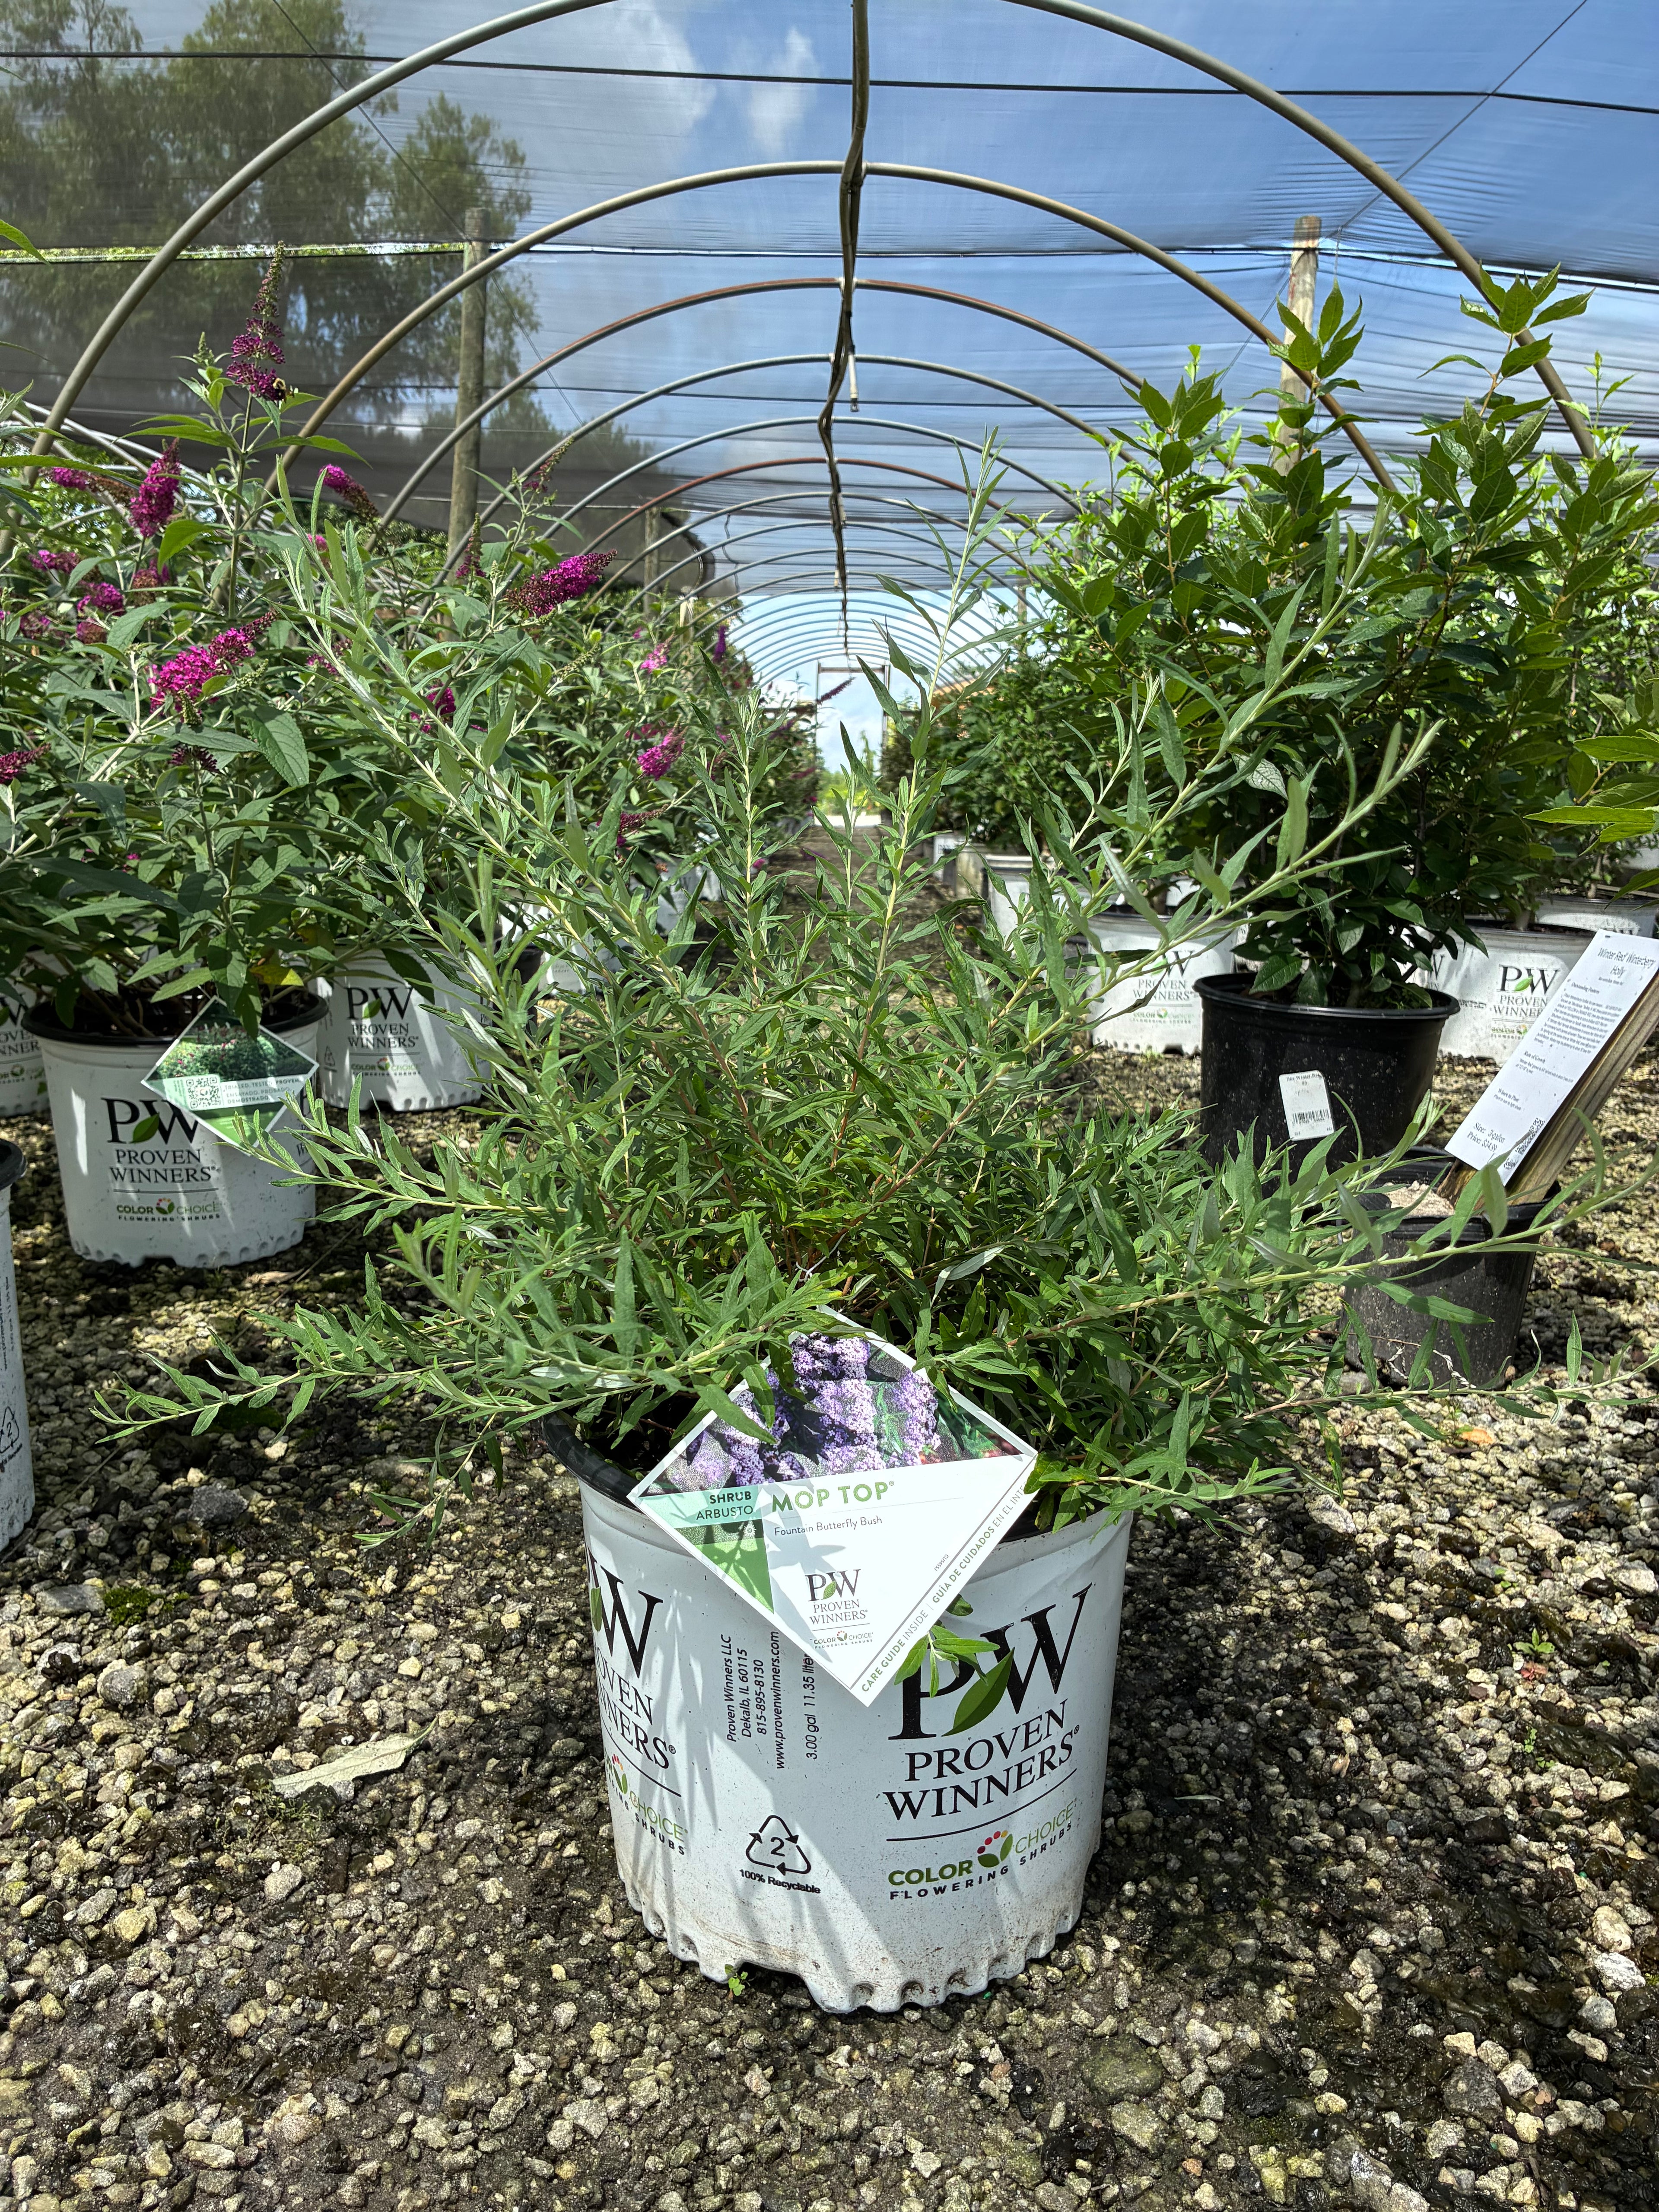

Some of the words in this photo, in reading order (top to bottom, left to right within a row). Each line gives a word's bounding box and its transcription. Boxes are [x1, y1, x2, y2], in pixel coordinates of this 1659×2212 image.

[1496, 964, 1560, 994] PW
[344, 986, 415, 1020] PW
[1493, 1004, 1544, 1017] WINNER
[352, 1023, 409, 1036] PROVEN
[115, 1148, 201, 1165] PROVEN
[116, 1204, 154, 1214] COLOR
[176, 1202, 219, 1214] CHOICE
[696, 1505, 753, 1520] ARBUSTO
[709, 1491, 752, 1504] SHRUB
[772, 1488, 830, 1513] MOP
[774, 1524, 814, 1536] Fountain
[817, 1518, 858, 1531] Butterfly
[861, 1515, 883, 1526] Bush
[804, 1569, 861, 1602] PW
[861, 1669, 883, 1692] CARE
[881, 1639, 906, 1668] GUIDE
[903, 1610, 928, 1640] INSIDE
[932, 1583, 952, 1603] GUÍA
[949, 1568, 961, 1583] DE
[959, 1526, 995, 1569] CUIDADOS
[992, 1513, 1005, 1527] EN
[1002, 1503, 1014, 1516] EL
[813, 1599, 860, 1613] PROVEN
[721, 1634, 732, 1656] LLC
[849, 1632, 873, 1641] CHOICE
[737, 1648, 749, 1683] 60115
[888, 1582, 1093, 1740] PW
[724, 1657, 734, 1702] Winners
[738, 1686, 749, 1695] IL
[802, 1676, 815, 1707] 11.35
[753, 1659, 767, 1735] 815-895-8130
[770, 1631, 786, 1769] www.provenwinners.com
[727, 1705, 737, 1742] Proven
[739, 1697, 752, 1738] Dekalb,
[804, 1713, 819, 1732] gal
[805, 1735, 817, 1760] 3.00
[904, 1698, 1068, 1782] PROVEN
[629, 1790, 684, 1843] CHOICE
[635, 1812, 685, 1855] SHRUBS
[770, 1837, 785, 1857] 2
[888, 1859, 973, 1886] COLOR
[1015, 1800, 1075, 1854] CHOICE
[890, 1865, 1009, 1900] FLOWERING
[1019, 1821, 1072, 1866] SHRUBS
[739, 1869, 766, 1883] 100%
[768, 1875, 821, 1894] Recyclable
